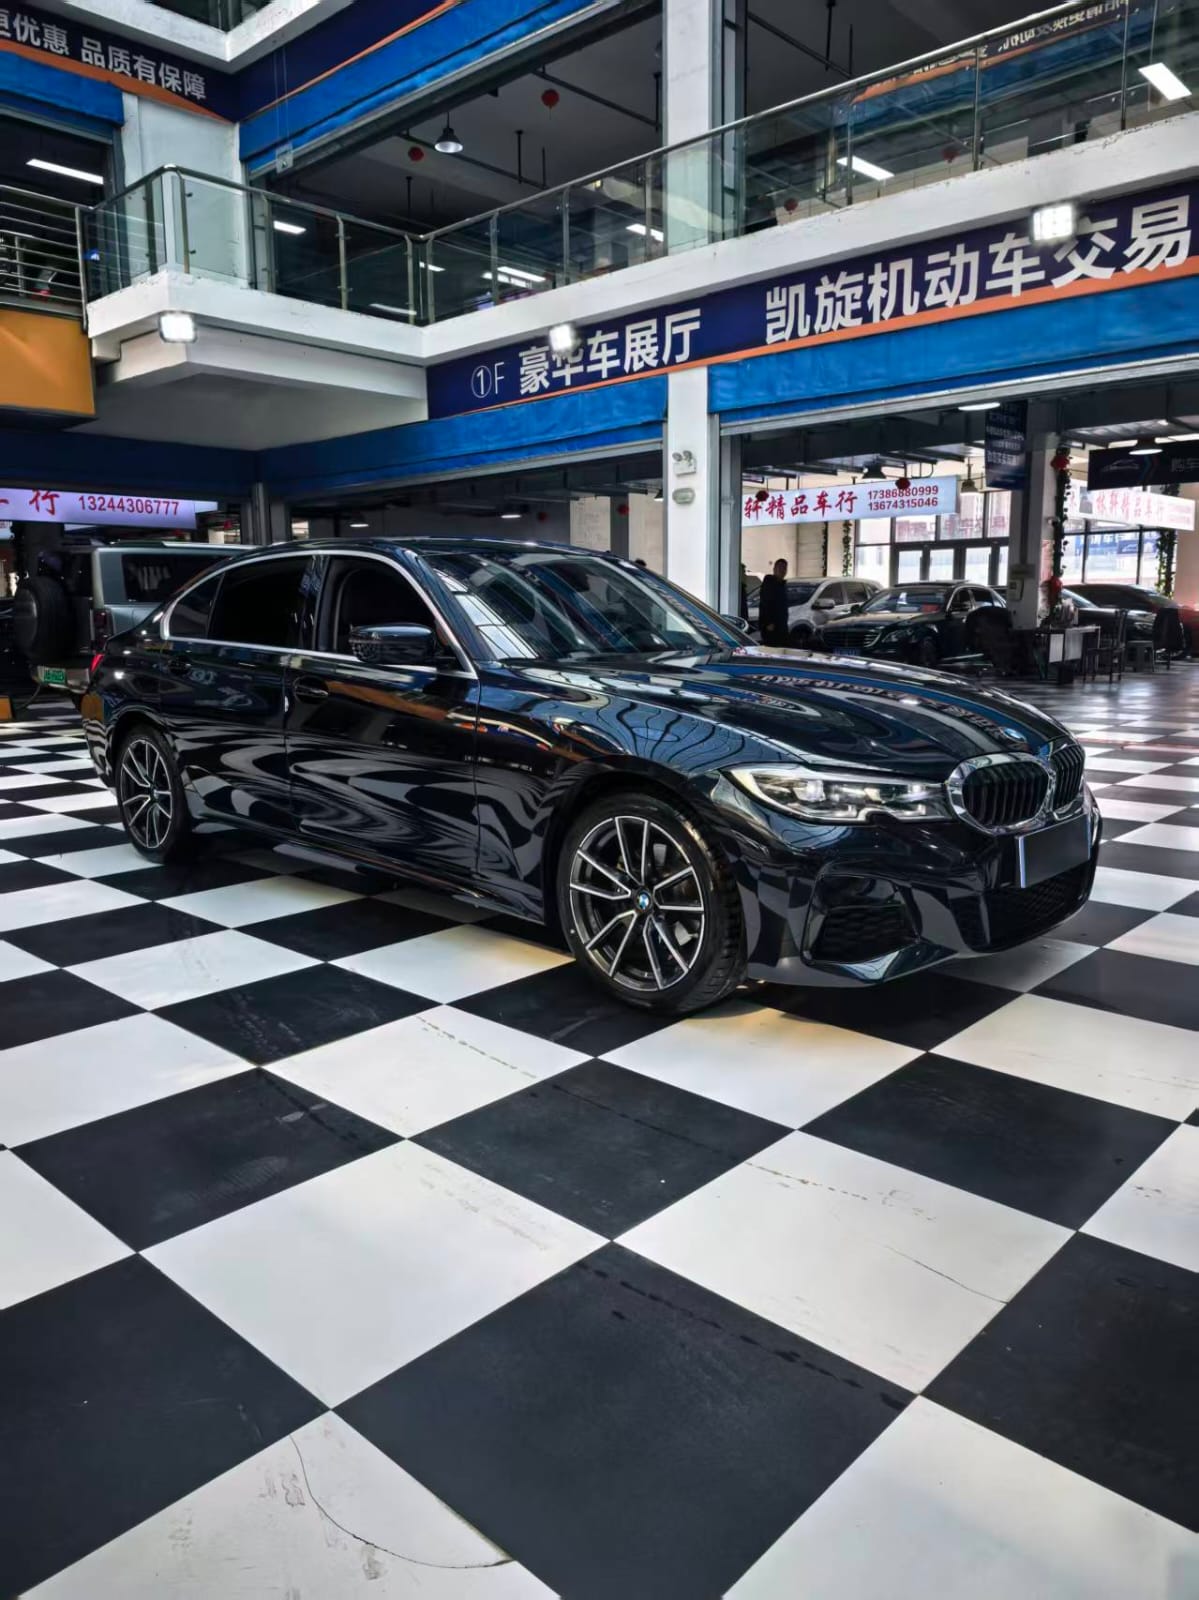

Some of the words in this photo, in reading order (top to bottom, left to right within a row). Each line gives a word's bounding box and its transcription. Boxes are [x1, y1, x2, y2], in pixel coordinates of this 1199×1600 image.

[81, 36, 206, 100] 品质有保障
[765, 195, 1191, 346] 凯旋机动车交易
[518, 309, 701, 396] 豪华车展厅
[78, 494, 180, 516] 13244306777
[867, 484, 939, 501] 17386880999
[867, 496, 939, 512] 13674315046
